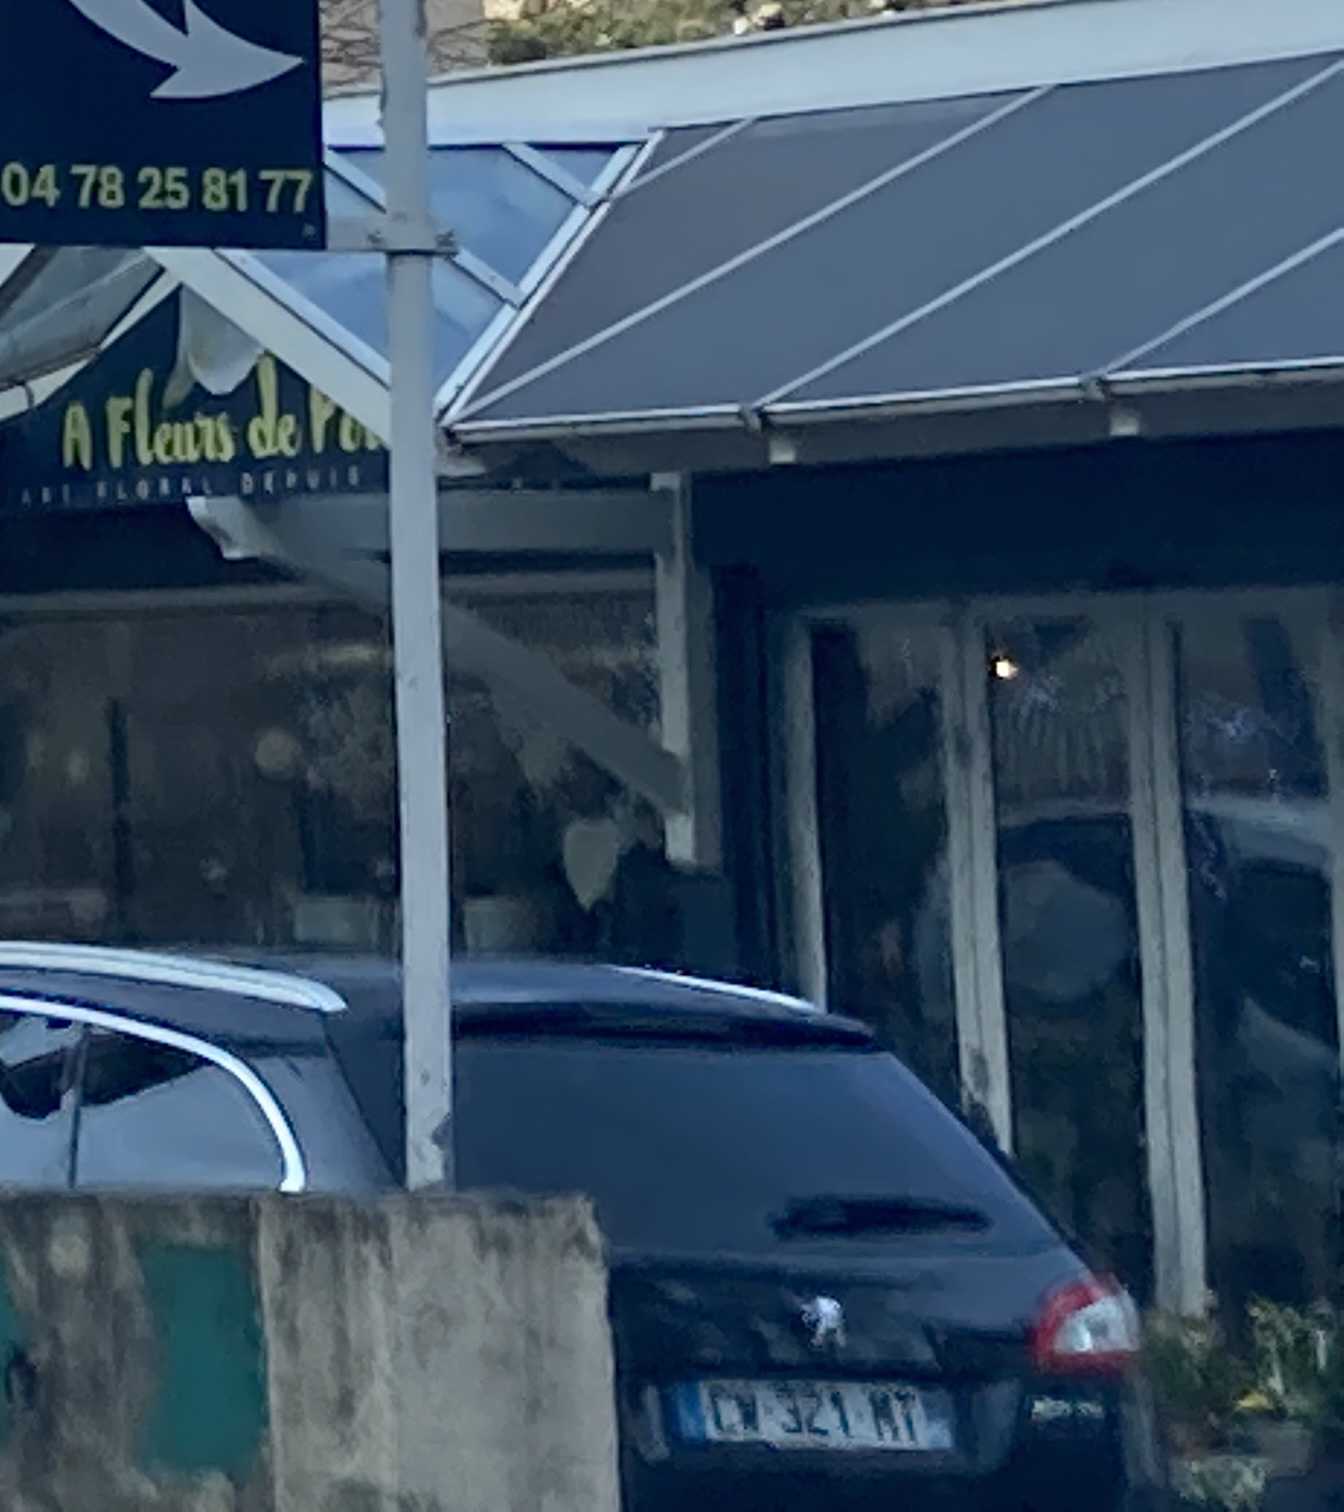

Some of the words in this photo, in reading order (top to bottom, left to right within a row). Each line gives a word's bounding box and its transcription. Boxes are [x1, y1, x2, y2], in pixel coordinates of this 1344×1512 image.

[0, 161, 60, 207] 04
[70, 164, 125, 209] 78
[137, 166, 190, 210] 25
[201, 168, 248, 212] 81
[257, 169, 313, 213] 77
[62, 400, 92, 471] A
[105, 367, 235, 469] Fleurs
[247, 350, 301, 459] de
